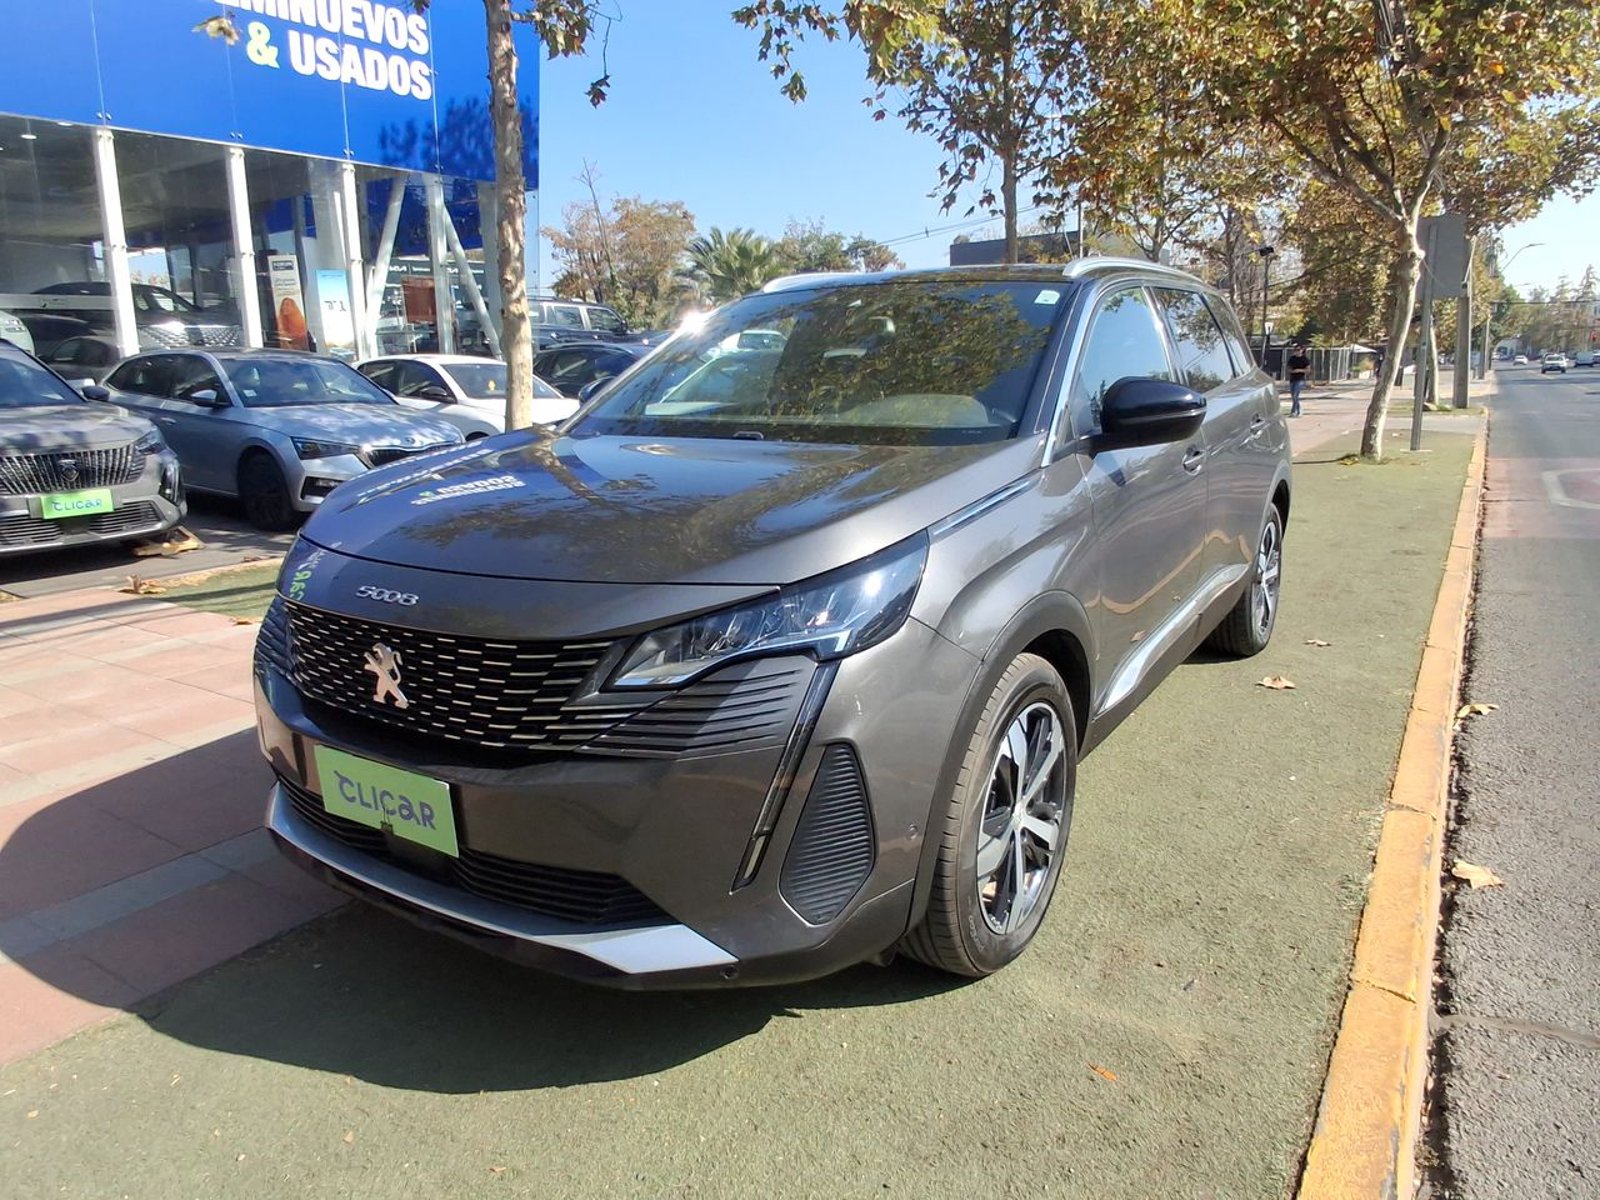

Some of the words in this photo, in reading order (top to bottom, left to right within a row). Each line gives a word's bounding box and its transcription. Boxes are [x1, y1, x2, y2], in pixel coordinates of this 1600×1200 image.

[214, 0, 430, 55] INUEVOS
[246, 21, 280, 69] &
[288, 29, 433, 101] USADOS
[355, 584, 419, 606] 5008
